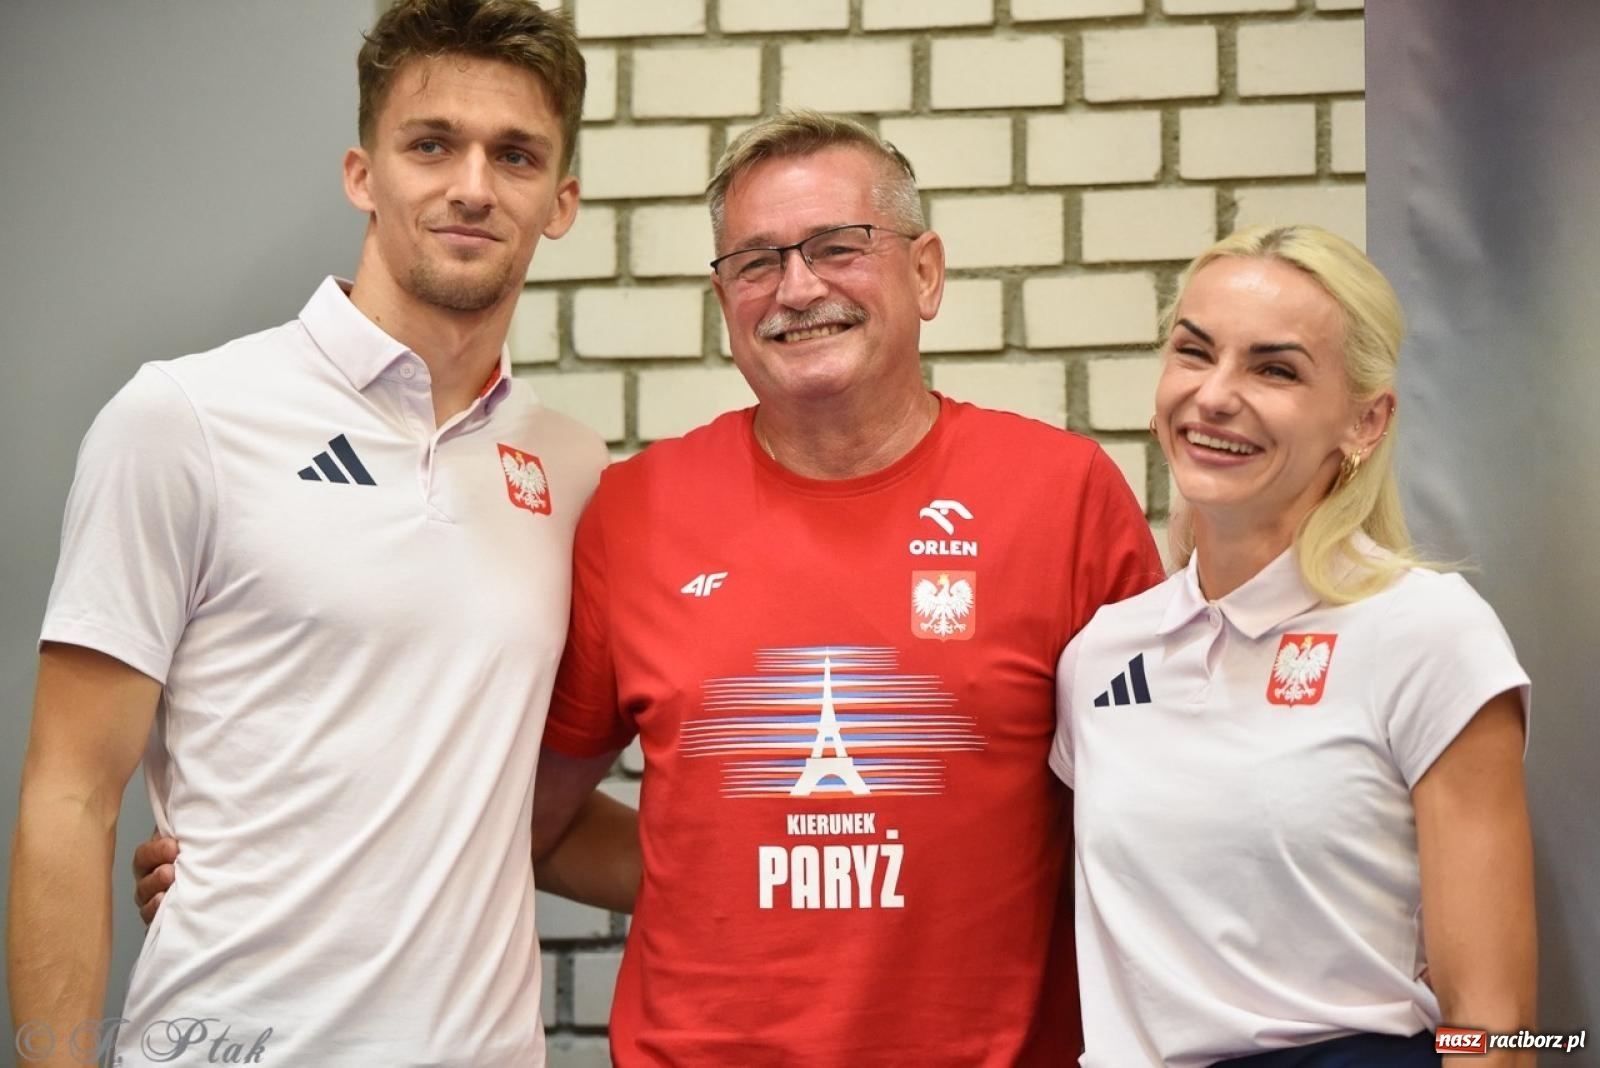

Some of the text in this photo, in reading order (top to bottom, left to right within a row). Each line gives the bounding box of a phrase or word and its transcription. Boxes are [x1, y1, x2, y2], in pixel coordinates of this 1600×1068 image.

[908, 539, 978, 557] ORLEN
[680, 571, 728, 597] 4F
[786, 812, 876, 835] KIERUNEK
[758, 829, 905, 909] PARYŻ
